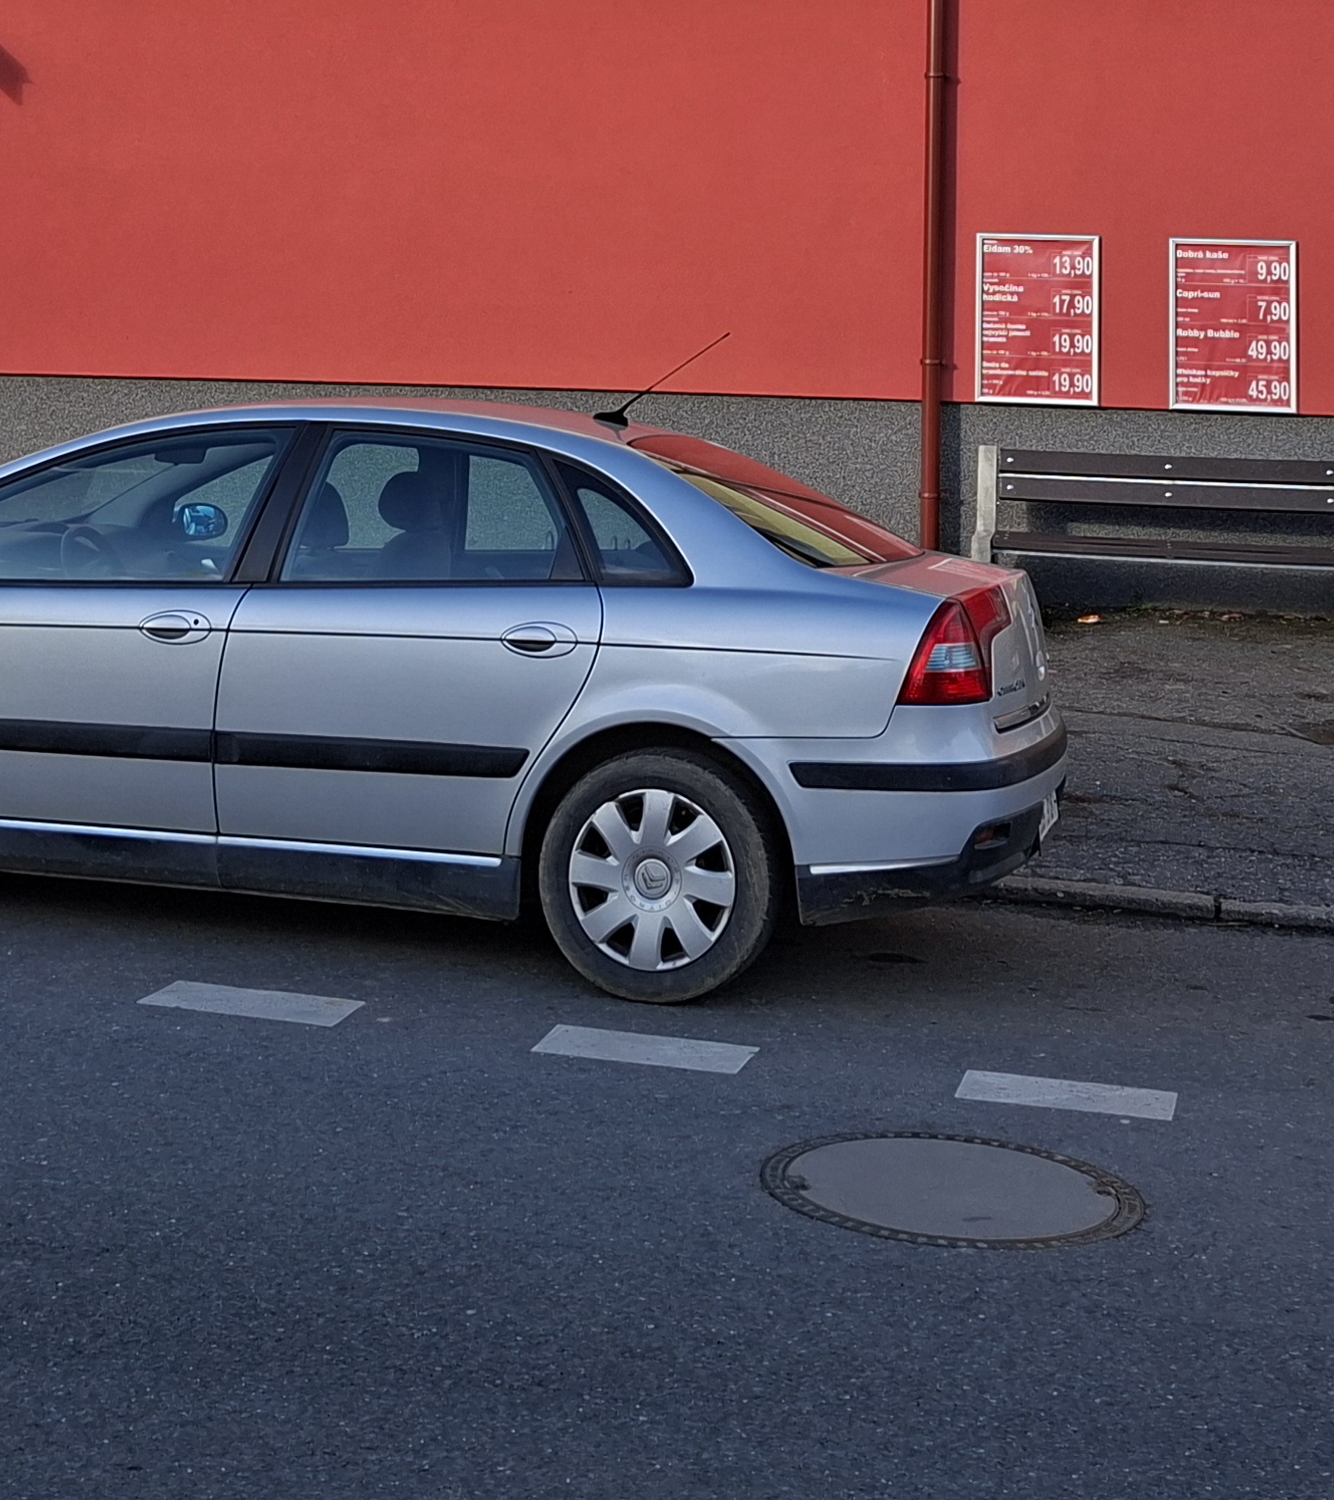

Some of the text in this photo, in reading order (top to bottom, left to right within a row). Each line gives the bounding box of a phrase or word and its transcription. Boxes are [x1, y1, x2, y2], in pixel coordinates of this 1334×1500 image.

[1052, 255, 1092, 277] 13,90
[1257, 261, 1289, 283] 9,90
[1052, 295, 1092, 317] 17,90
[1257, 301, 1289, 323] 7,90
[1052, 333, 1092, 356] 19,90
[1247, 340, 1289, 363] 49,90
[1052, 373, 1092, 395] 19,90
[1247, 380, 1289, 403] 45,90
